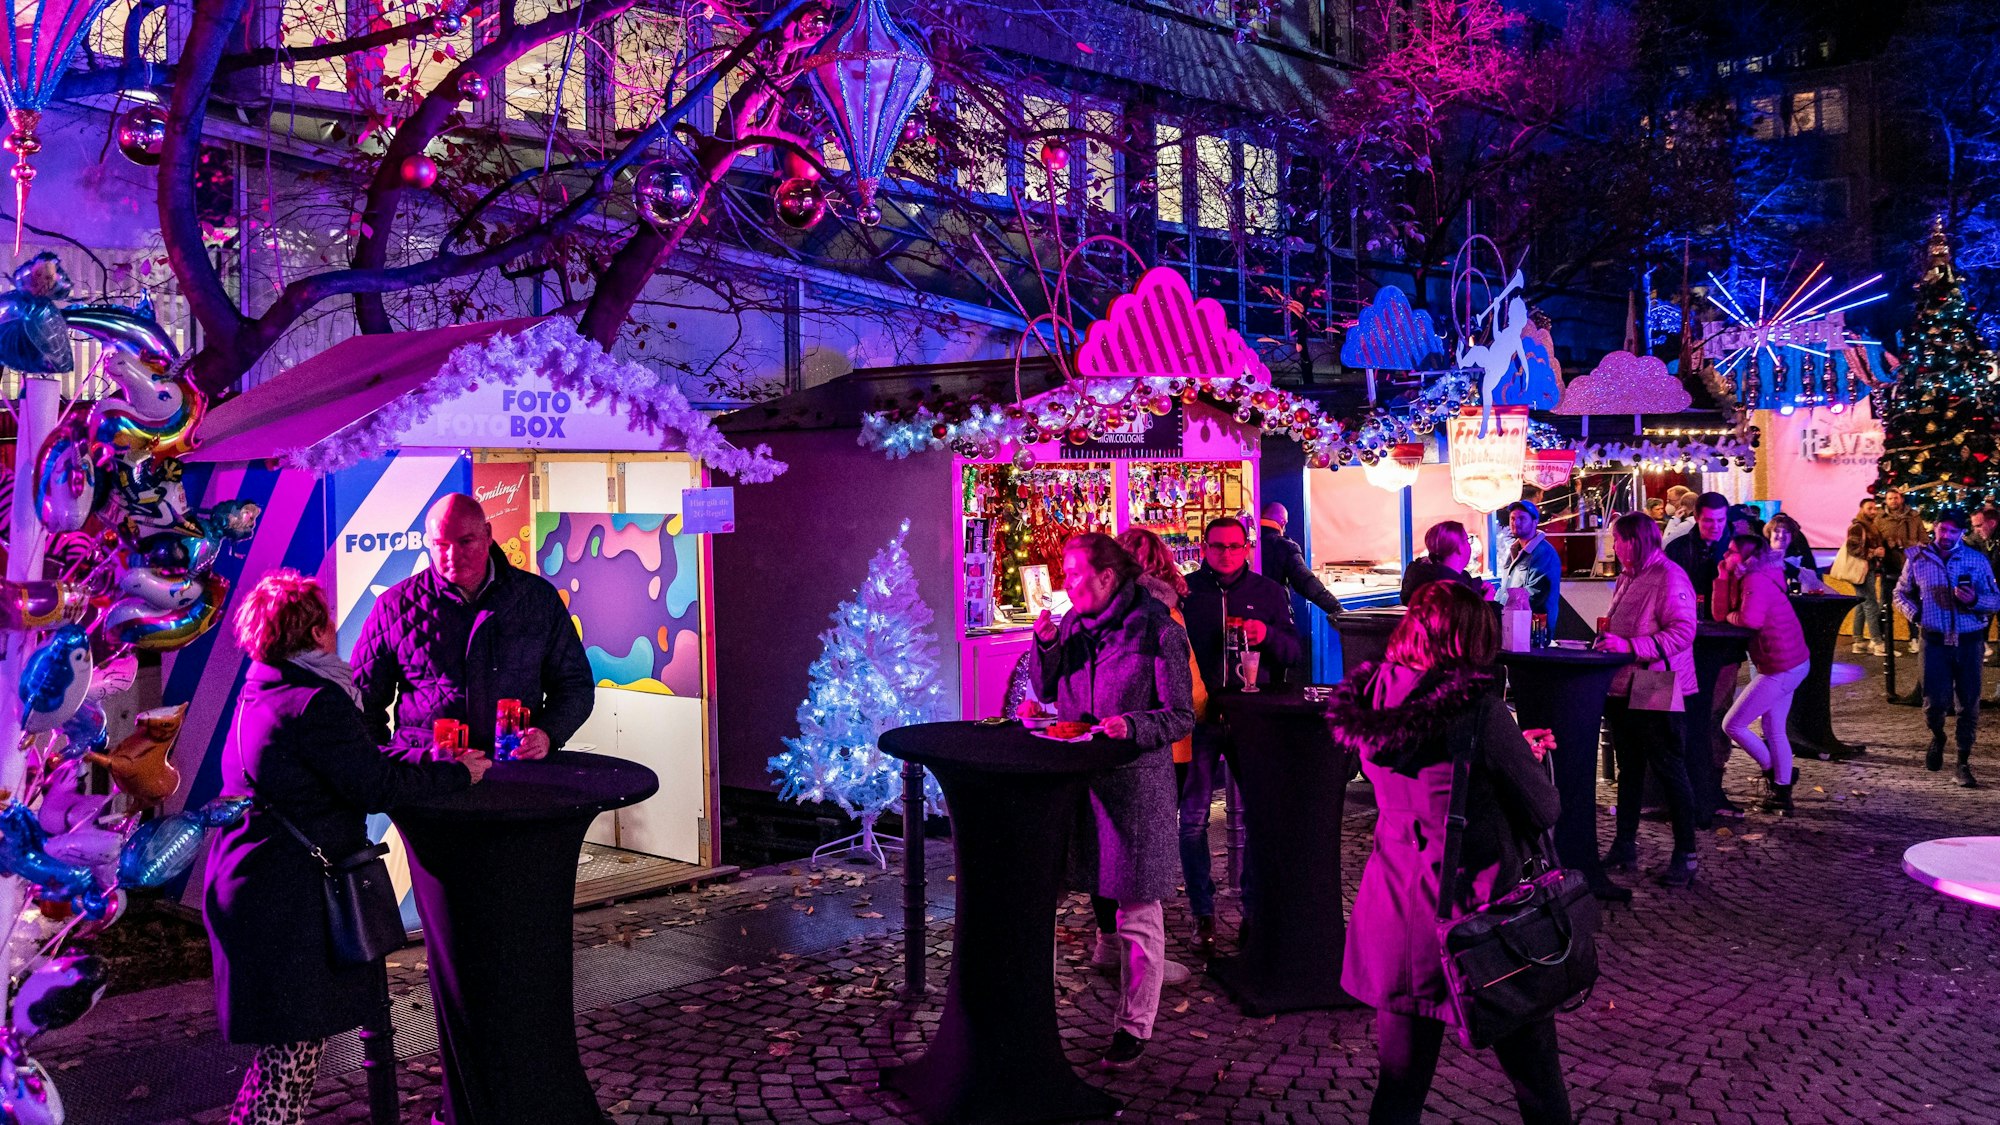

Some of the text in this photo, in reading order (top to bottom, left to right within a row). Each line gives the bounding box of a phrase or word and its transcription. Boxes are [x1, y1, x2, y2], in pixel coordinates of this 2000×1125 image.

[503, 390, 571, 413] FOTO
[437, 413, 566, 438] FOTO BOX
[1523, 463, 1568, 475] Champignons
[475, 475, 525, 504] Smiling!
